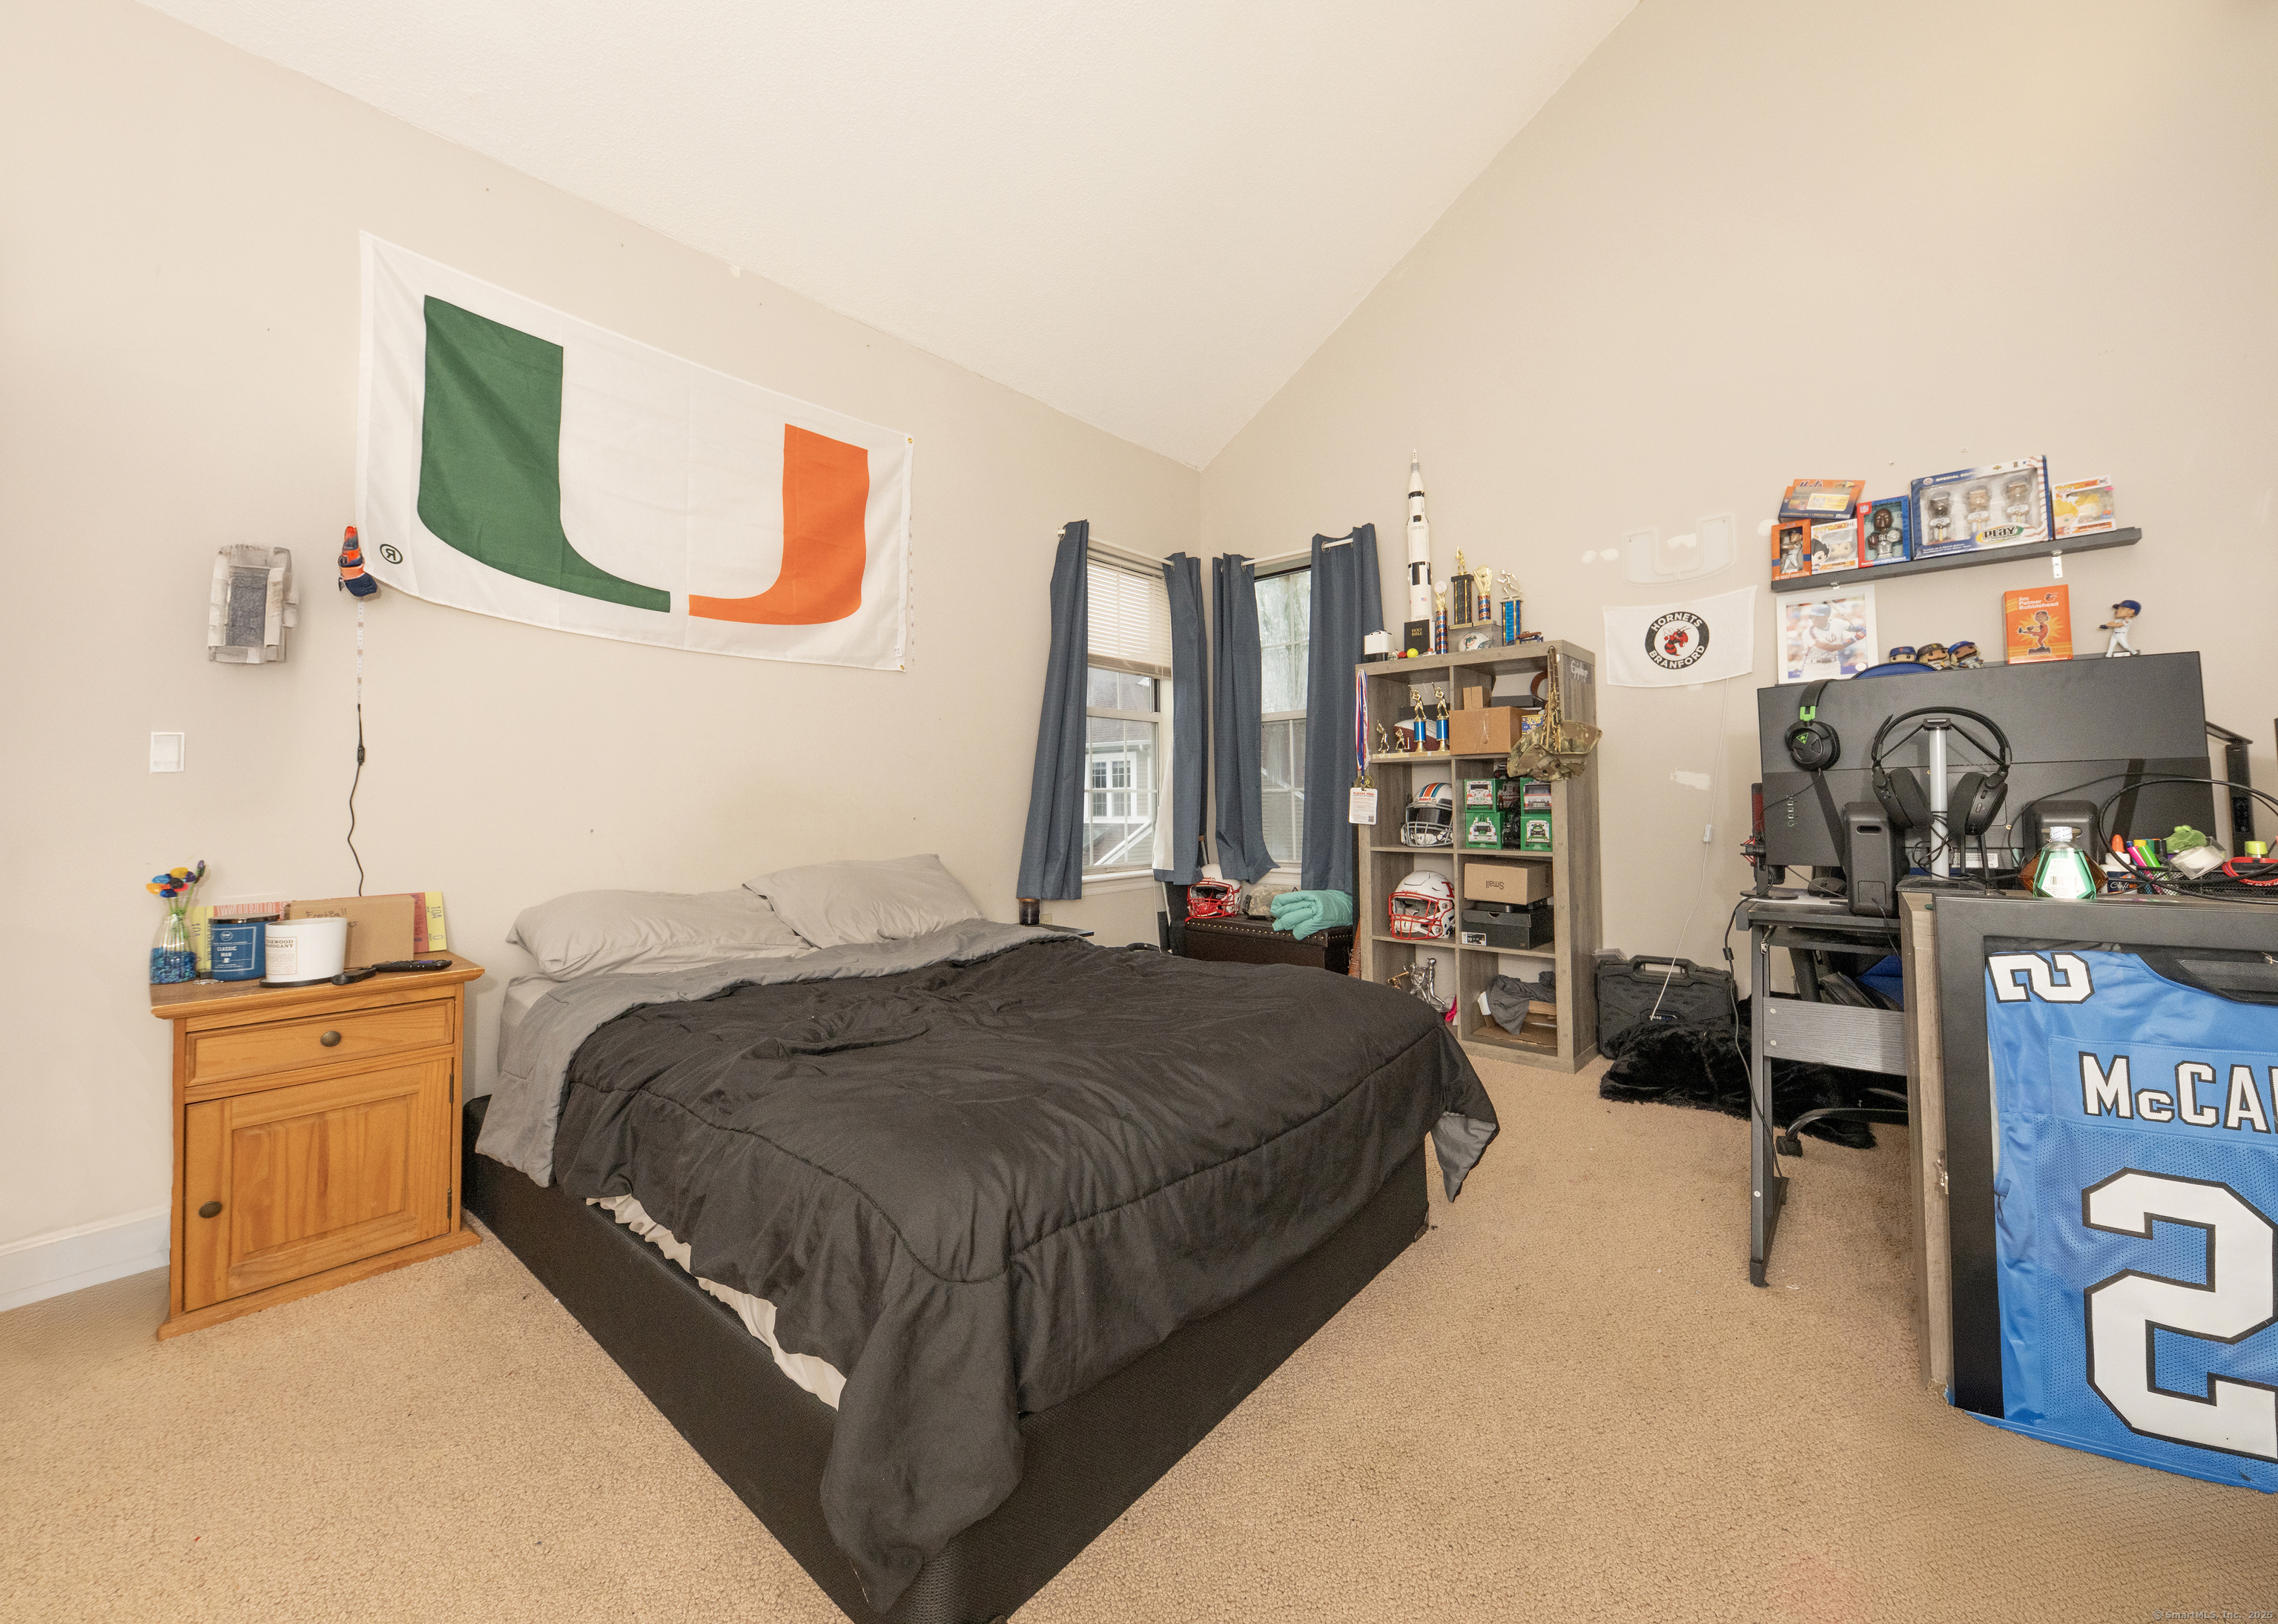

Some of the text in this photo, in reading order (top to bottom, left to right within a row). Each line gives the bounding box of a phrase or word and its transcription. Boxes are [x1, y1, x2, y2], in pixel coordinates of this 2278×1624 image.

[2018, 601, 2059, 610] Bobblehead
[1651, 613, 1703, 632] HORNETS
[1649, 644, 1705, 669] BRANFORD
[1485, 880, 1504, 890] Small
[1987, 952, 2095, 1004] 2
[2079, 1051, 2278, 1135] McCA
[2081, 1167, 2278, 1461] 2
